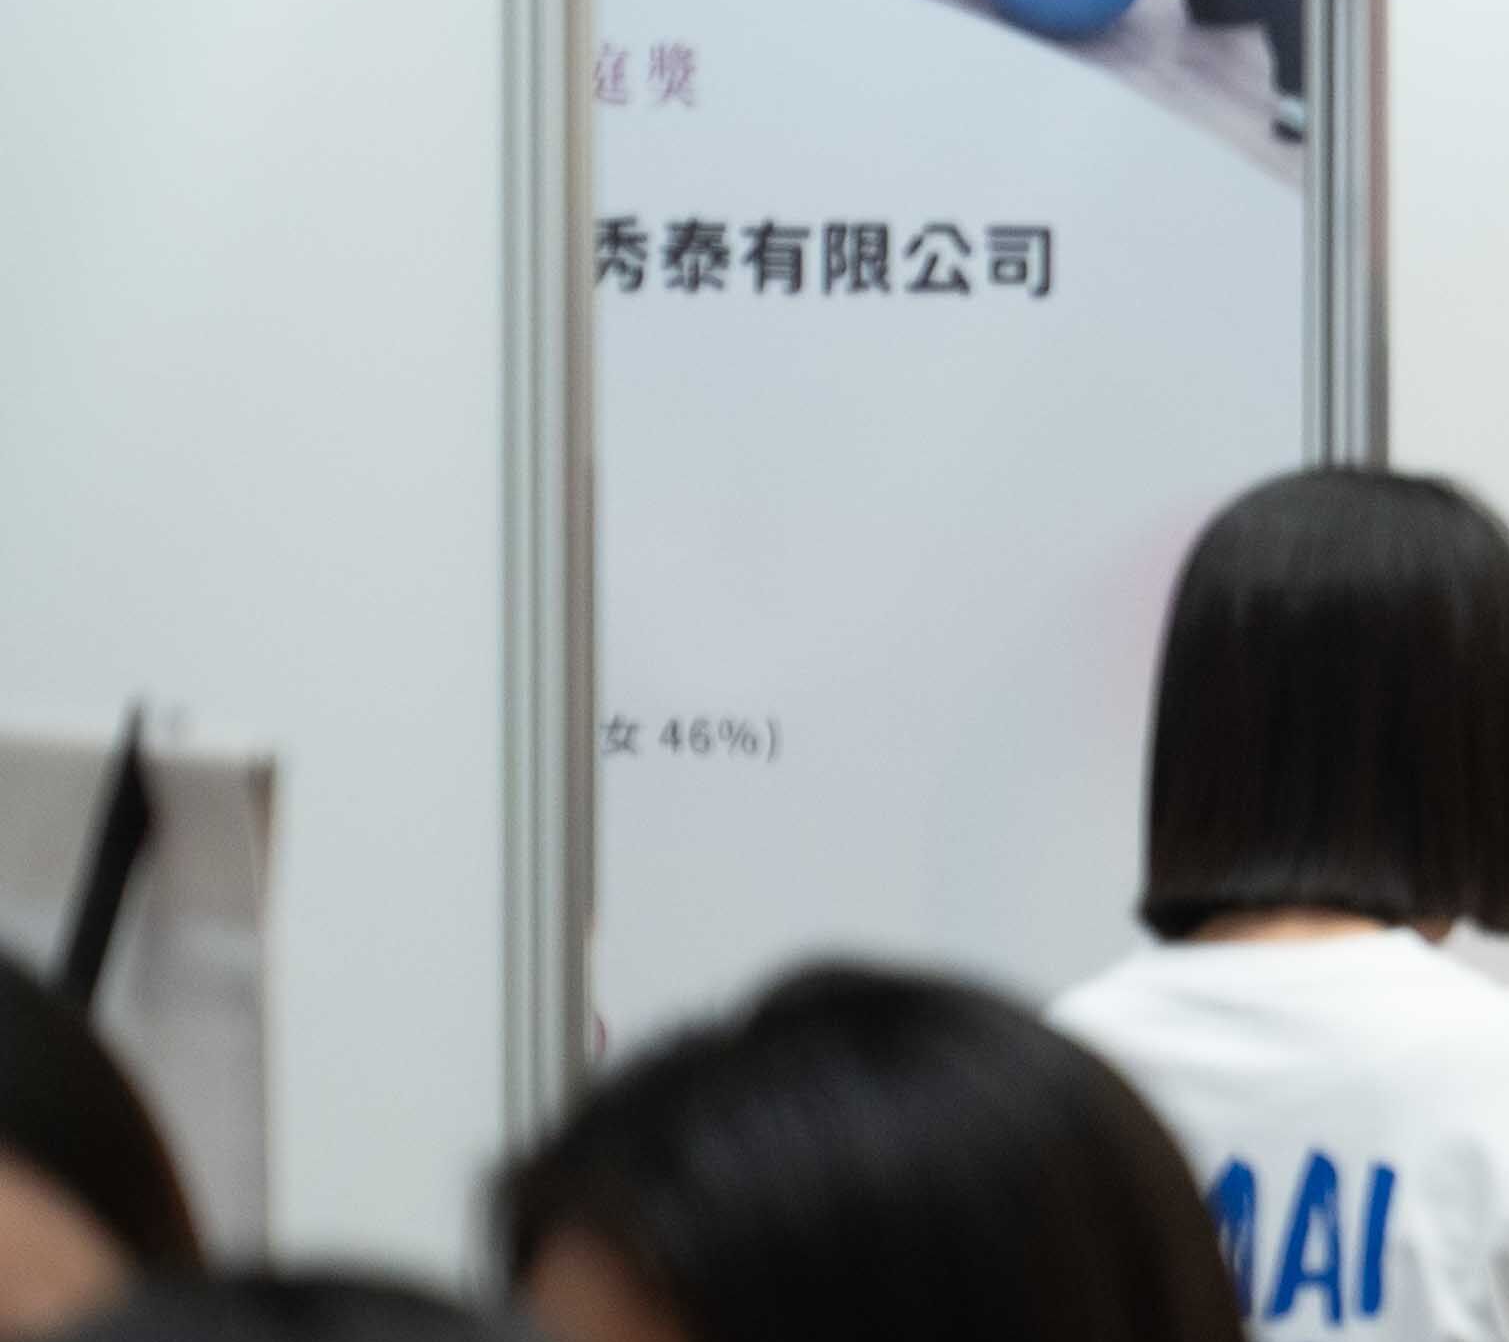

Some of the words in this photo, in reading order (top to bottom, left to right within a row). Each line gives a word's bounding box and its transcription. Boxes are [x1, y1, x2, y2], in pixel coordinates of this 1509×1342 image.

[594, 215, 1052, 298] 秀泰有限公司
